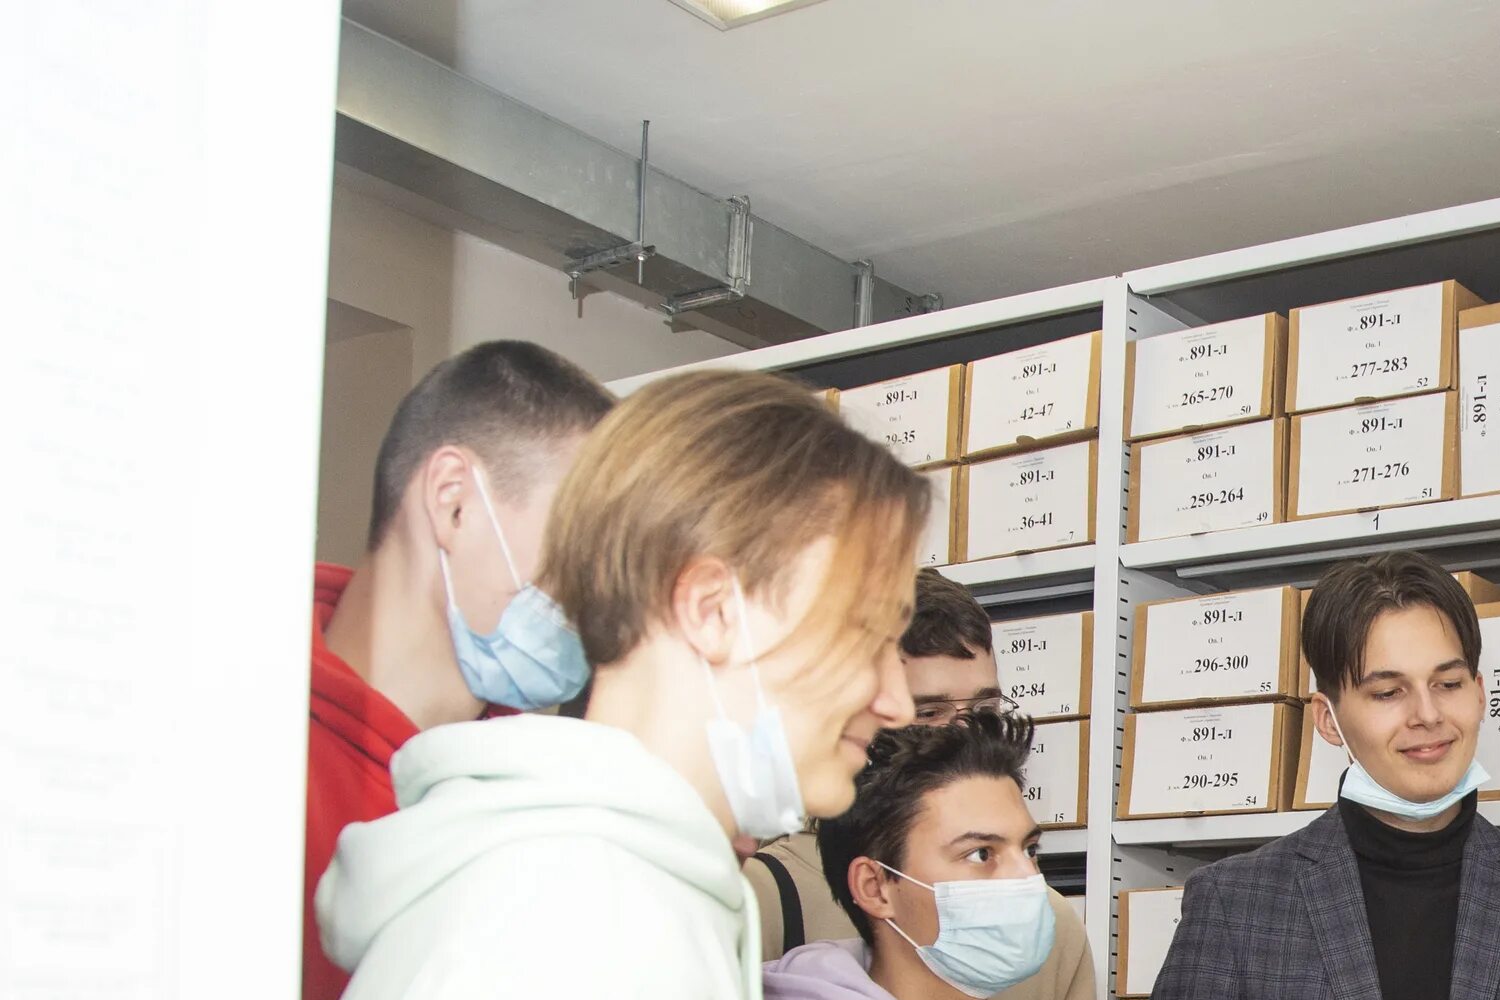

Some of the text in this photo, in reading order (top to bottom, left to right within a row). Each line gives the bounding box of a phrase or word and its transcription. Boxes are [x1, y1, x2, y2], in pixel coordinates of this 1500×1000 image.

[1359, 313, 1401, 330] 891-л
[1189, 343, 1227, 361] 891-л
[1022, 363, 1056, 379] 891-л
[1350, 356, 1408, 378] 277-283
[1417, 376, 1429, 387] 52
[885, 389, 917, 405] 891-л
[1181, 385, 1234, 407] 265-270
[1472, 375, 1487, 424] 891-л
[1020, 402, 1054, 421] 42-47
[1240, 404, 1252, 414] 50
[1361, 416, 1403, 434] 891-л
[1197, 444, 1236, 461] 891-л
[1019, 469, 1054, 486] 891-л
[1352, 462, 1410, 483] 271-276
[1190, 487, 1244, 510] 259-264
[1421, 487, 1433, 499] 51
[1019, 511, 1053, 530] 36-41
[1256, 511, 1268, 522] 49
[1068, 530, 1075, 541] 7
[1203, 608, 1243, 625] 891-л
[1011, 638, 1047, 654] 891-л
[1194, 654, 1249, 673] 296-300
[1010, 682, 1045, 699] 82-84
[1259, 681, 1272, 693] 55
[1060, 703, 1070, 714] 16
[1192, 726, 1232, 742] 891-л
[1182, 772, 1239, 789] 290-295
[1245, 795, 1257, 806] 54
[1054, 812, 1064, 823] 15
